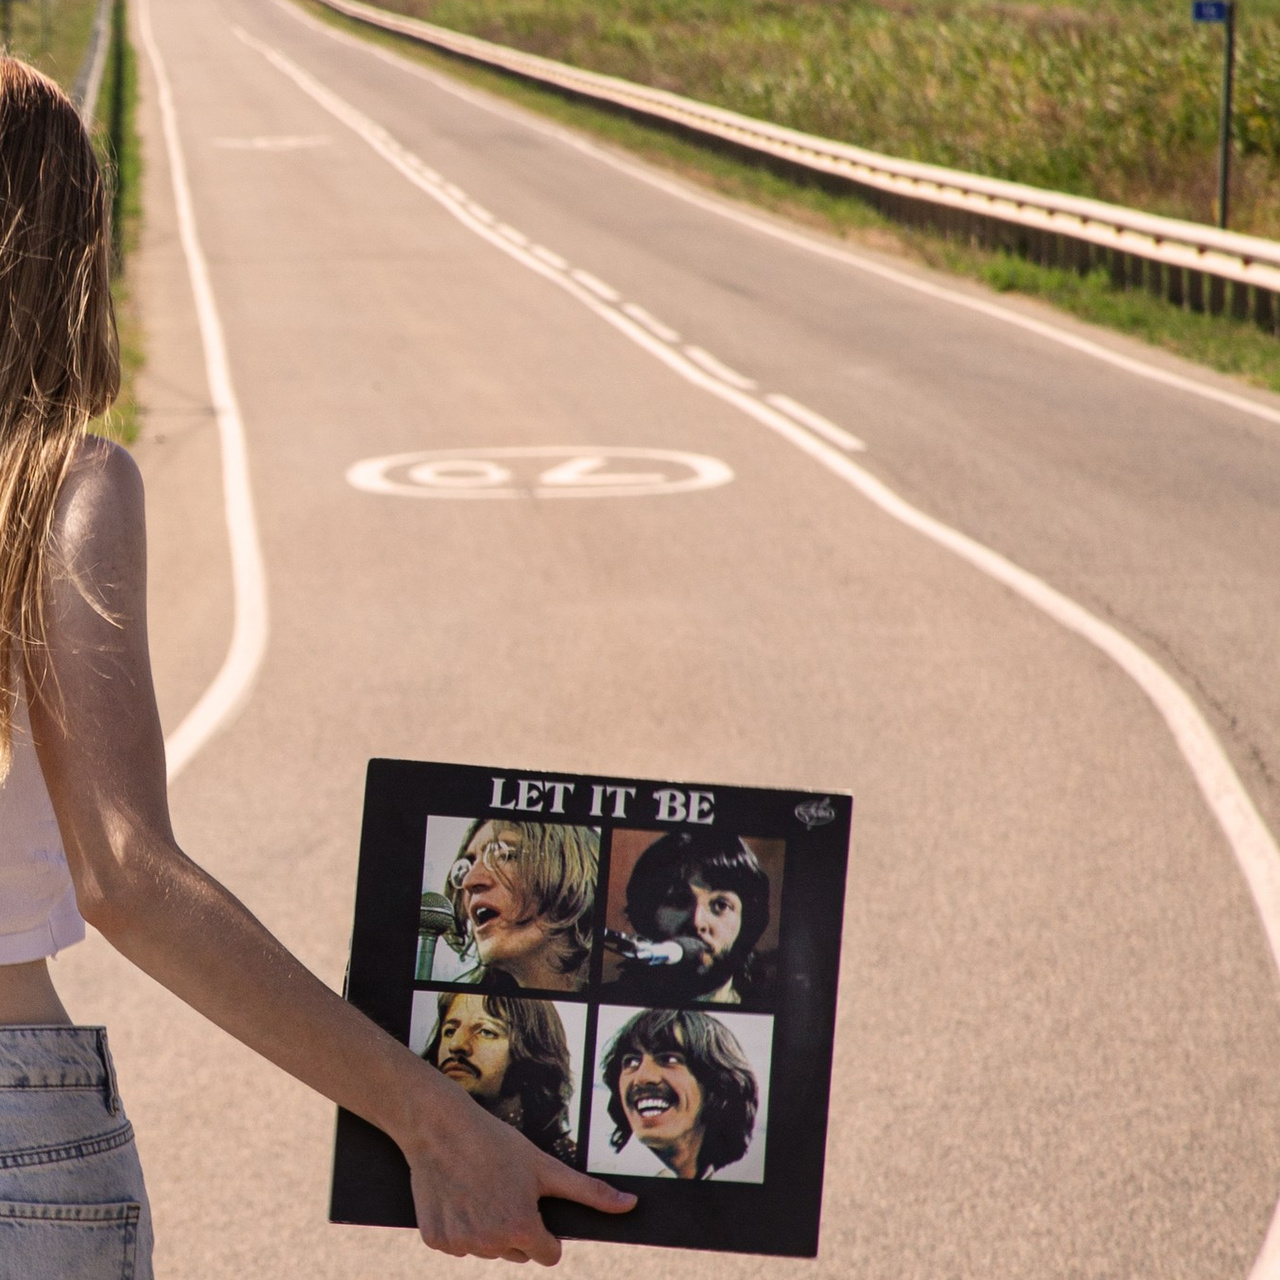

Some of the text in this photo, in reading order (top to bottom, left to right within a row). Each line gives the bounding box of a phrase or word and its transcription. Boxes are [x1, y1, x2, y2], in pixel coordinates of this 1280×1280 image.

[489, 777, 715, 825] LET IT BE
